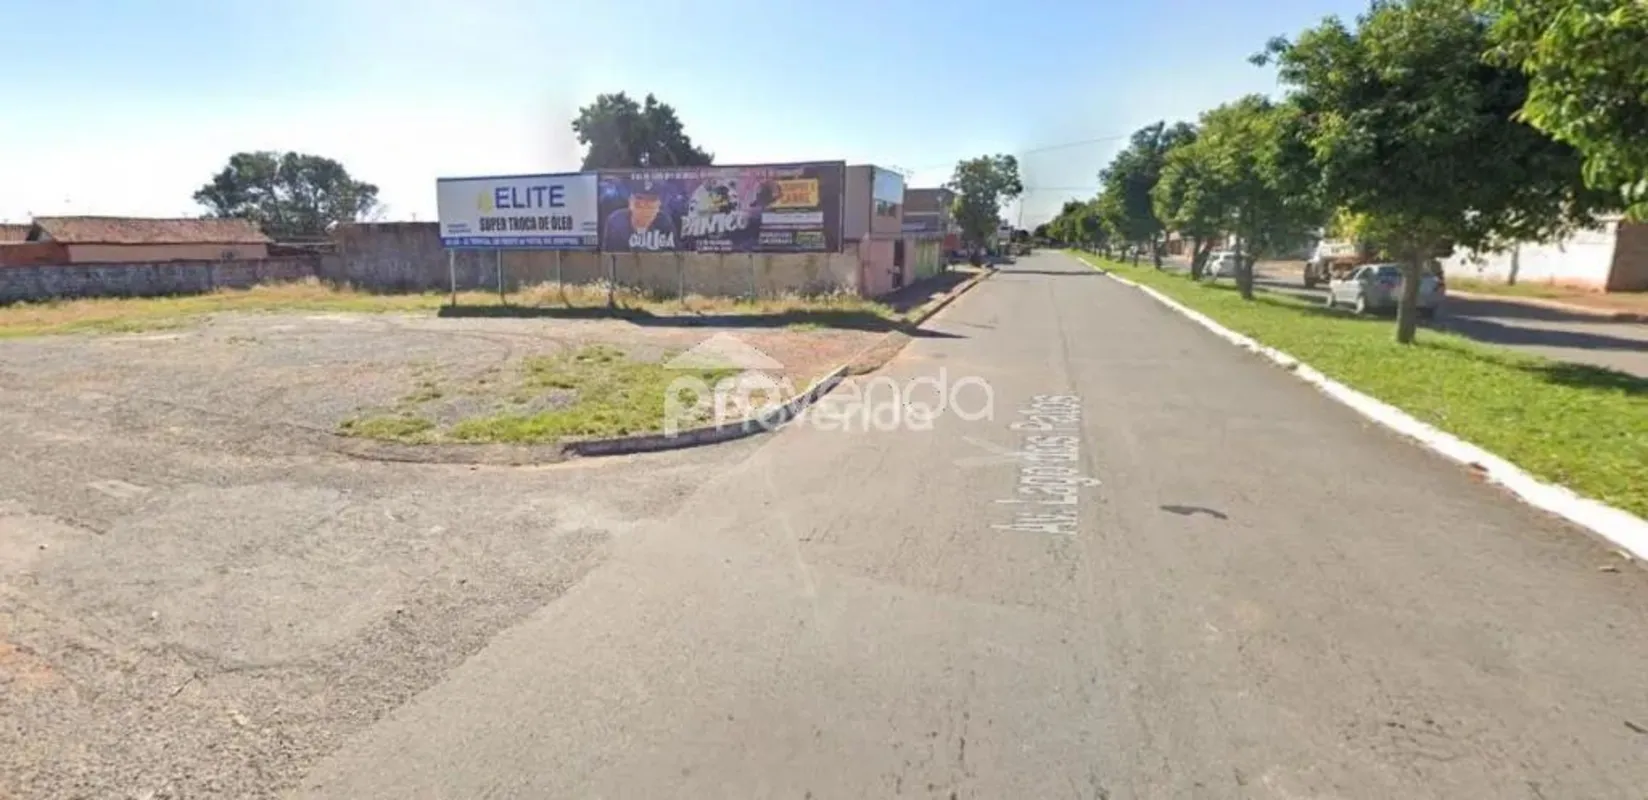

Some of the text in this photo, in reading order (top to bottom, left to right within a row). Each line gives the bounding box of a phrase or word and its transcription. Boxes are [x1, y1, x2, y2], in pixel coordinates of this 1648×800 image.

[495, 185, 565, 208] ELITE
[480, 216, 507, 232] SUPER
[508, 215, 537, 231] TROCA
[538, 215, 549, 231] DE
